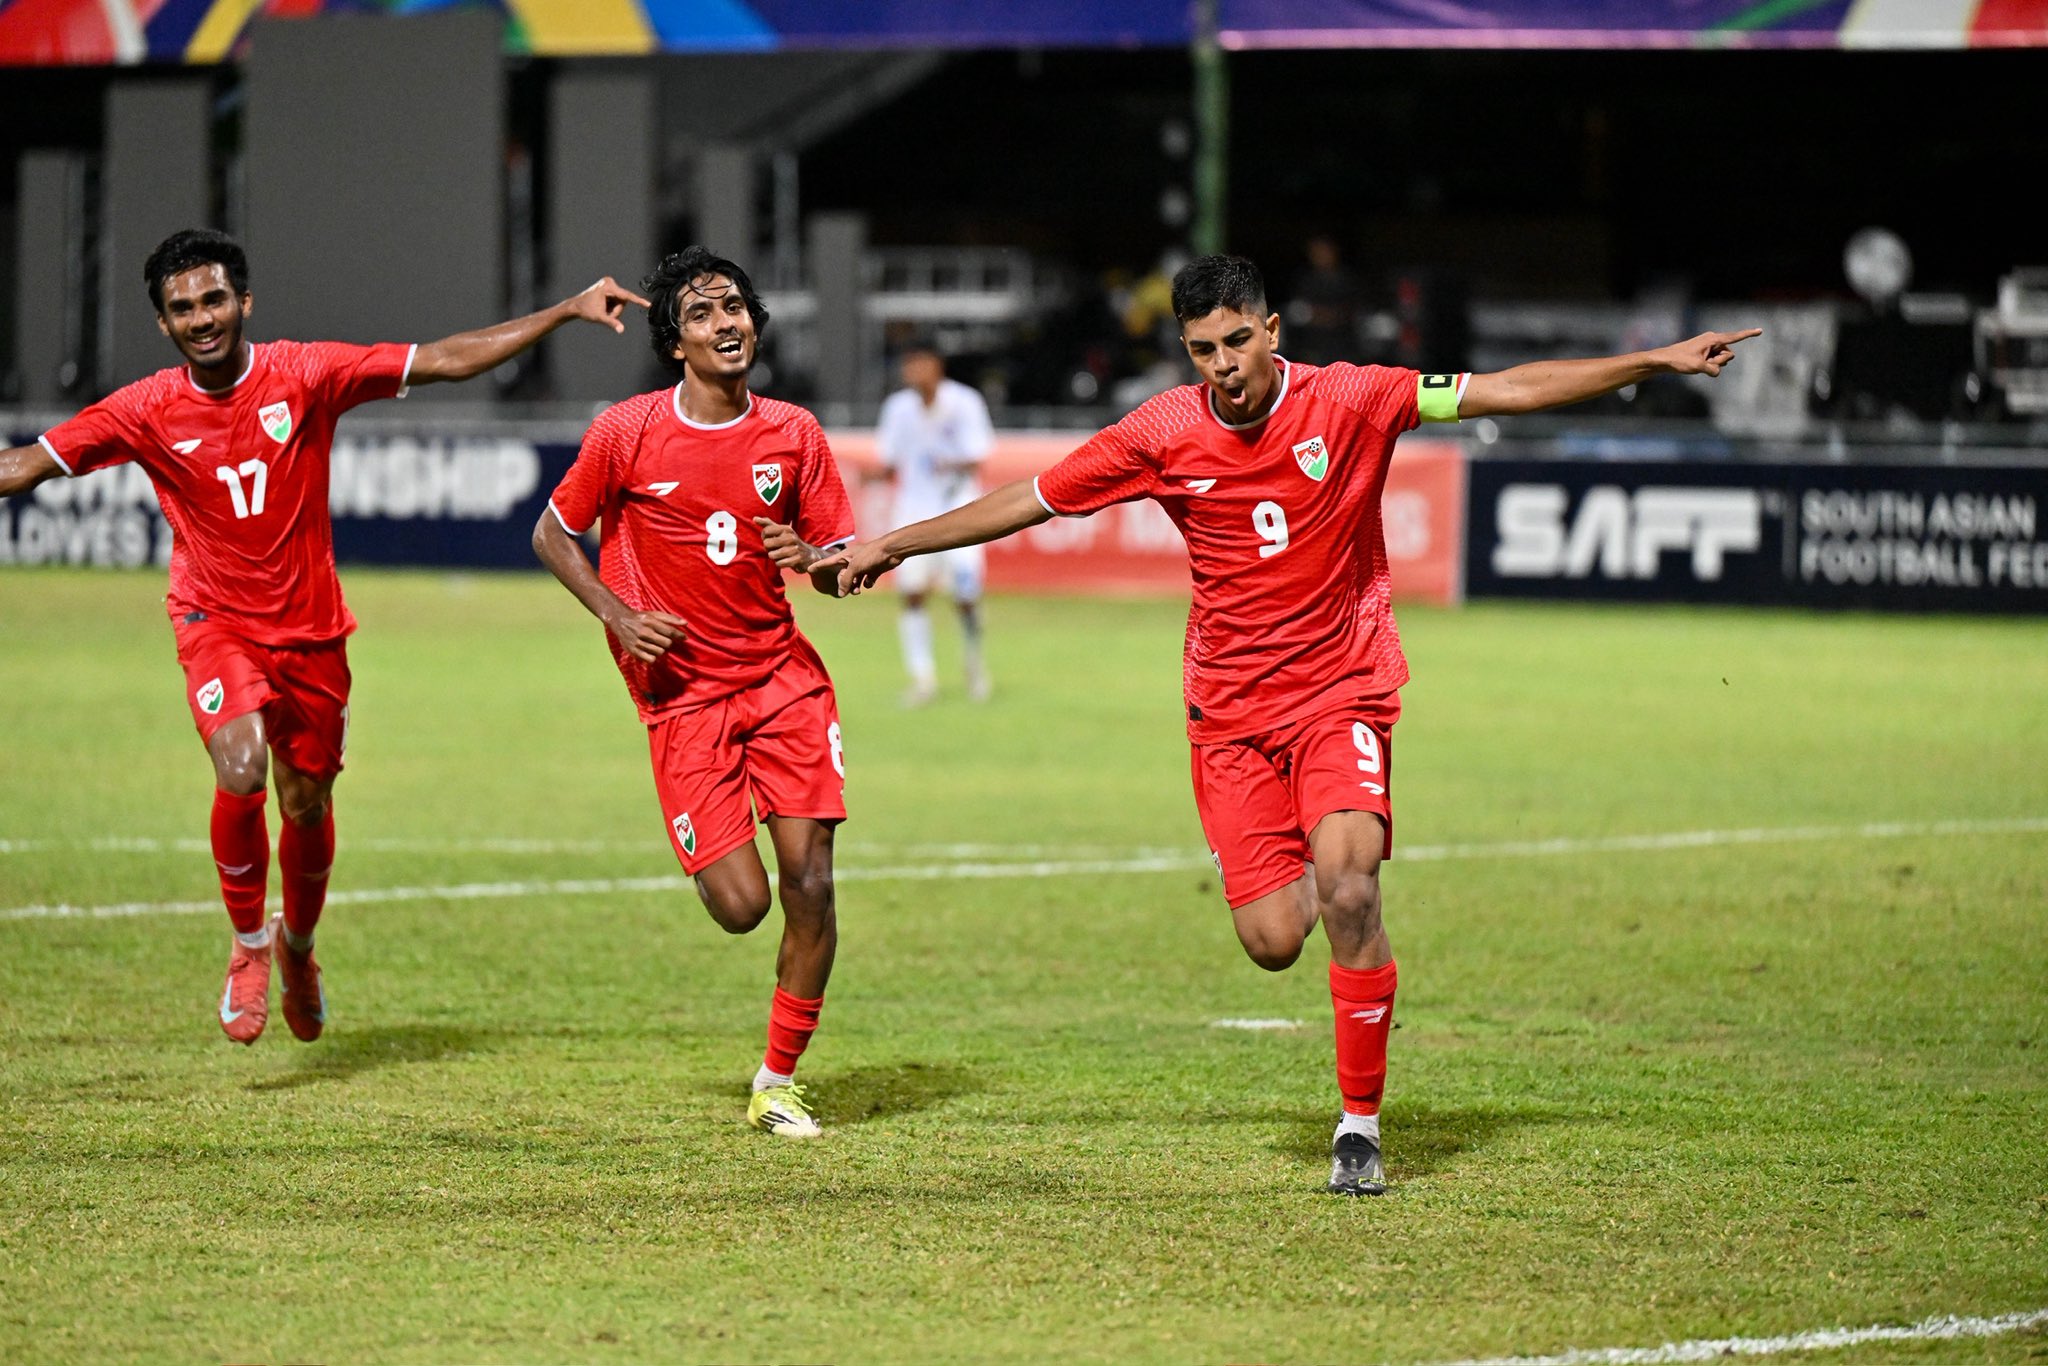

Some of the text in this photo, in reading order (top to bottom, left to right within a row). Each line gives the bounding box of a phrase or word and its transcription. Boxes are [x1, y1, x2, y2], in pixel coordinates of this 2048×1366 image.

[216, 458, 268, 519] 17
[1802, 489, 1925, 538] SOUTH
[1928, 491, 2037, 541] ASIAN
[706, 511, 738, 565] 8
[1252, 501, 1289, 558] 9
[1492, 484, 1760, 580] SAFF
[1801, 538, 1983, 587] FOOTBALL
[1352, 722, 1380, 774] 9
